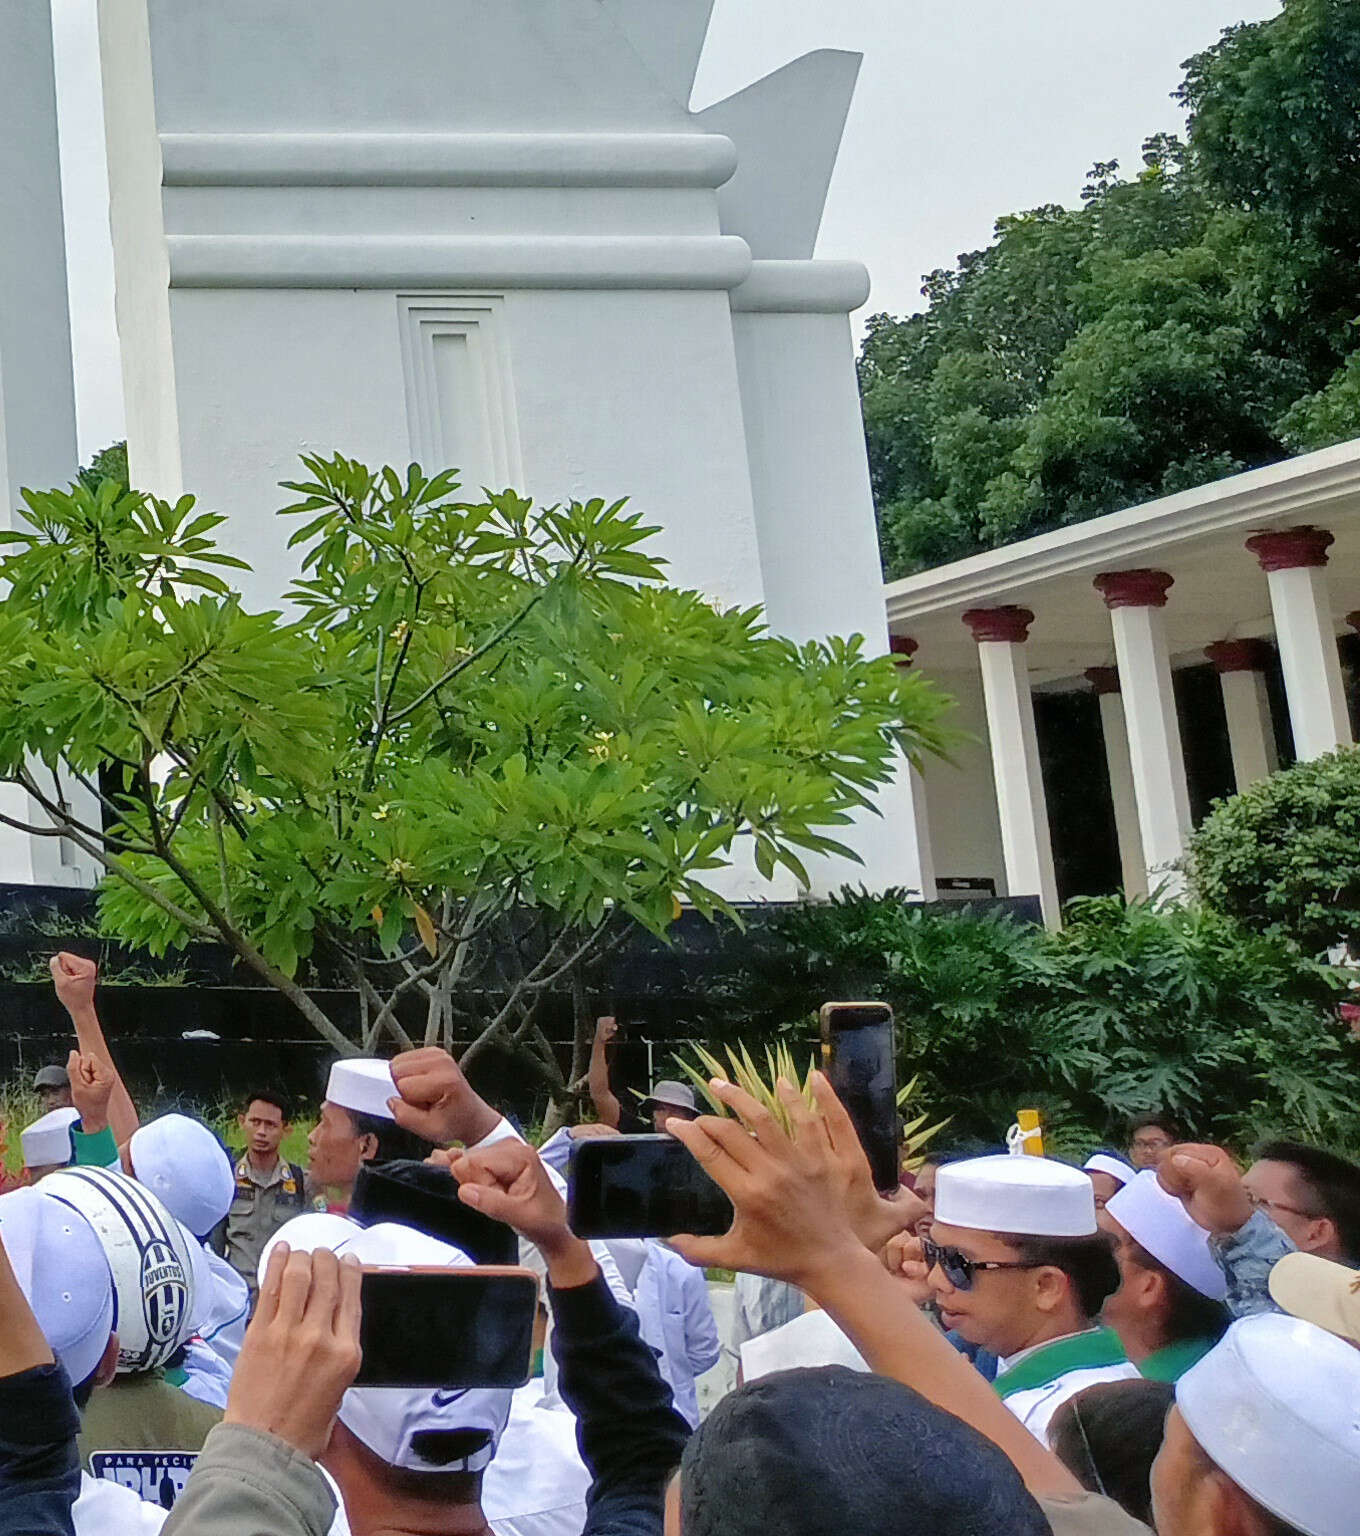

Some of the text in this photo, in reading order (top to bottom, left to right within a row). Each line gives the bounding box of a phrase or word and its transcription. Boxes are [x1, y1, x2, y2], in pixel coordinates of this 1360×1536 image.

[144, 1264, 183, 1288] JUVENTUS
[104, 1456, 200, 1467] PARA PECIN
